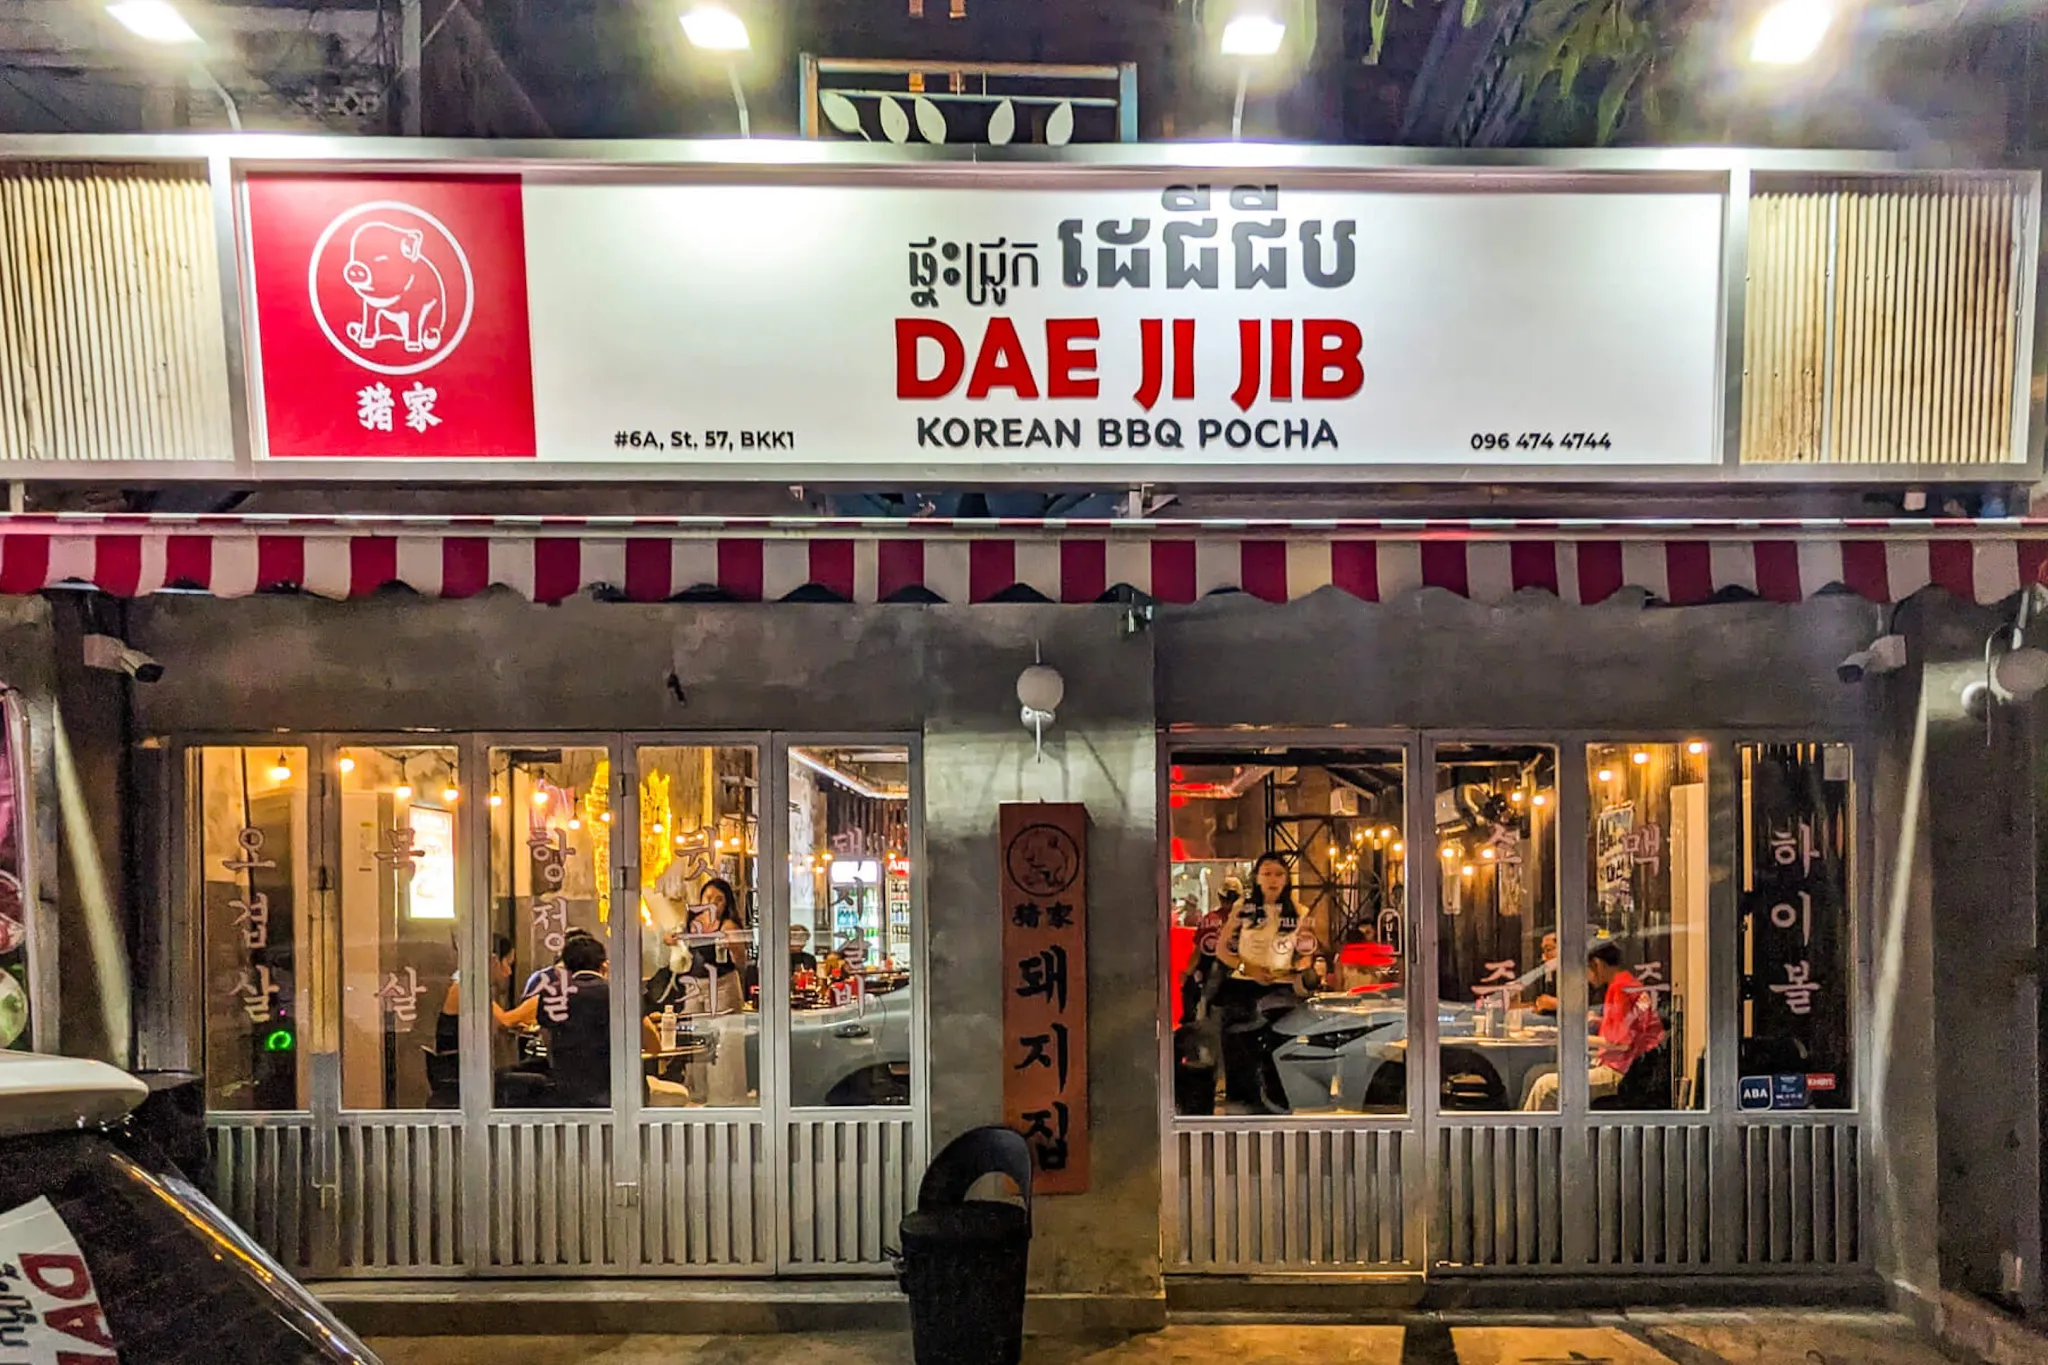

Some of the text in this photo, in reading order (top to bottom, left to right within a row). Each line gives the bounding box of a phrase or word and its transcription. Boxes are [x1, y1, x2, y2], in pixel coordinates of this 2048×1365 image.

[894, 317, 1365, 412] DAE JI JIB
[916, 417, 1339, 449] KOREAN BBQ POCHA
[614, 431, 794, 451] #6A, St. 57, BKK1
[1470, 433, 1611, 450] 096 474 4744
[222, 826, 279, 1022] 오겹살
[527, 827, 577, 1022] 항정살
[830, 826, 872, 1019] 돼지갈비
[1768, 822, 1820, 1015] 하이볼
[1014, 945, 1069, 1172] 돼지집
[1743, 1089, 1768, 1100] ABA
